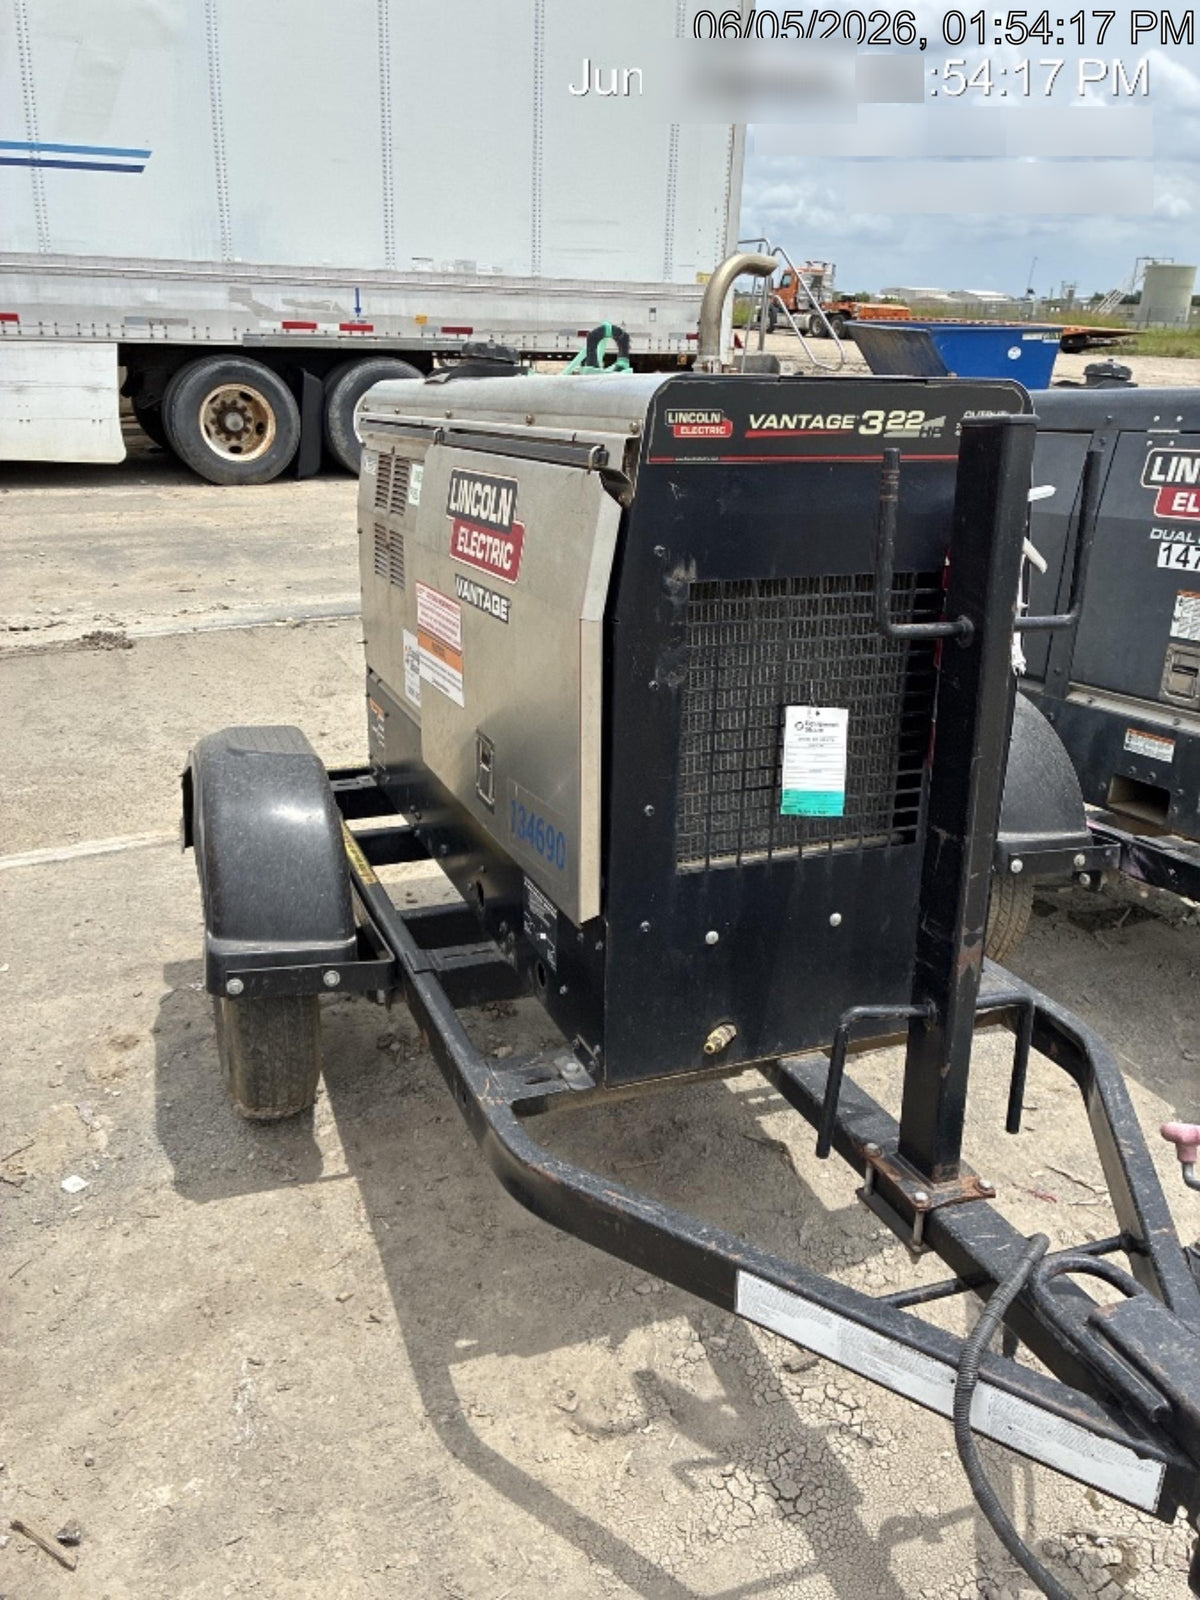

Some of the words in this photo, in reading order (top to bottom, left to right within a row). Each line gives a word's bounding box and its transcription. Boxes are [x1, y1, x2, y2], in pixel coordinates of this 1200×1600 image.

[668, 411, 722, 424] LINCOLN
[680, 425, 727, 435] ELECTRIC
[749, 413, 857, 430] VANTAGE
[858, 410, 926, 435] 322
[449, 478, 514, 526] LINCOLN
[456, 525, 515, 571] ELECTRIC
[1150, 527, 1196, 543] DUAL
[455, 576, 511, 621] VANTAGE
[511, 801, 566, 870] 134690
